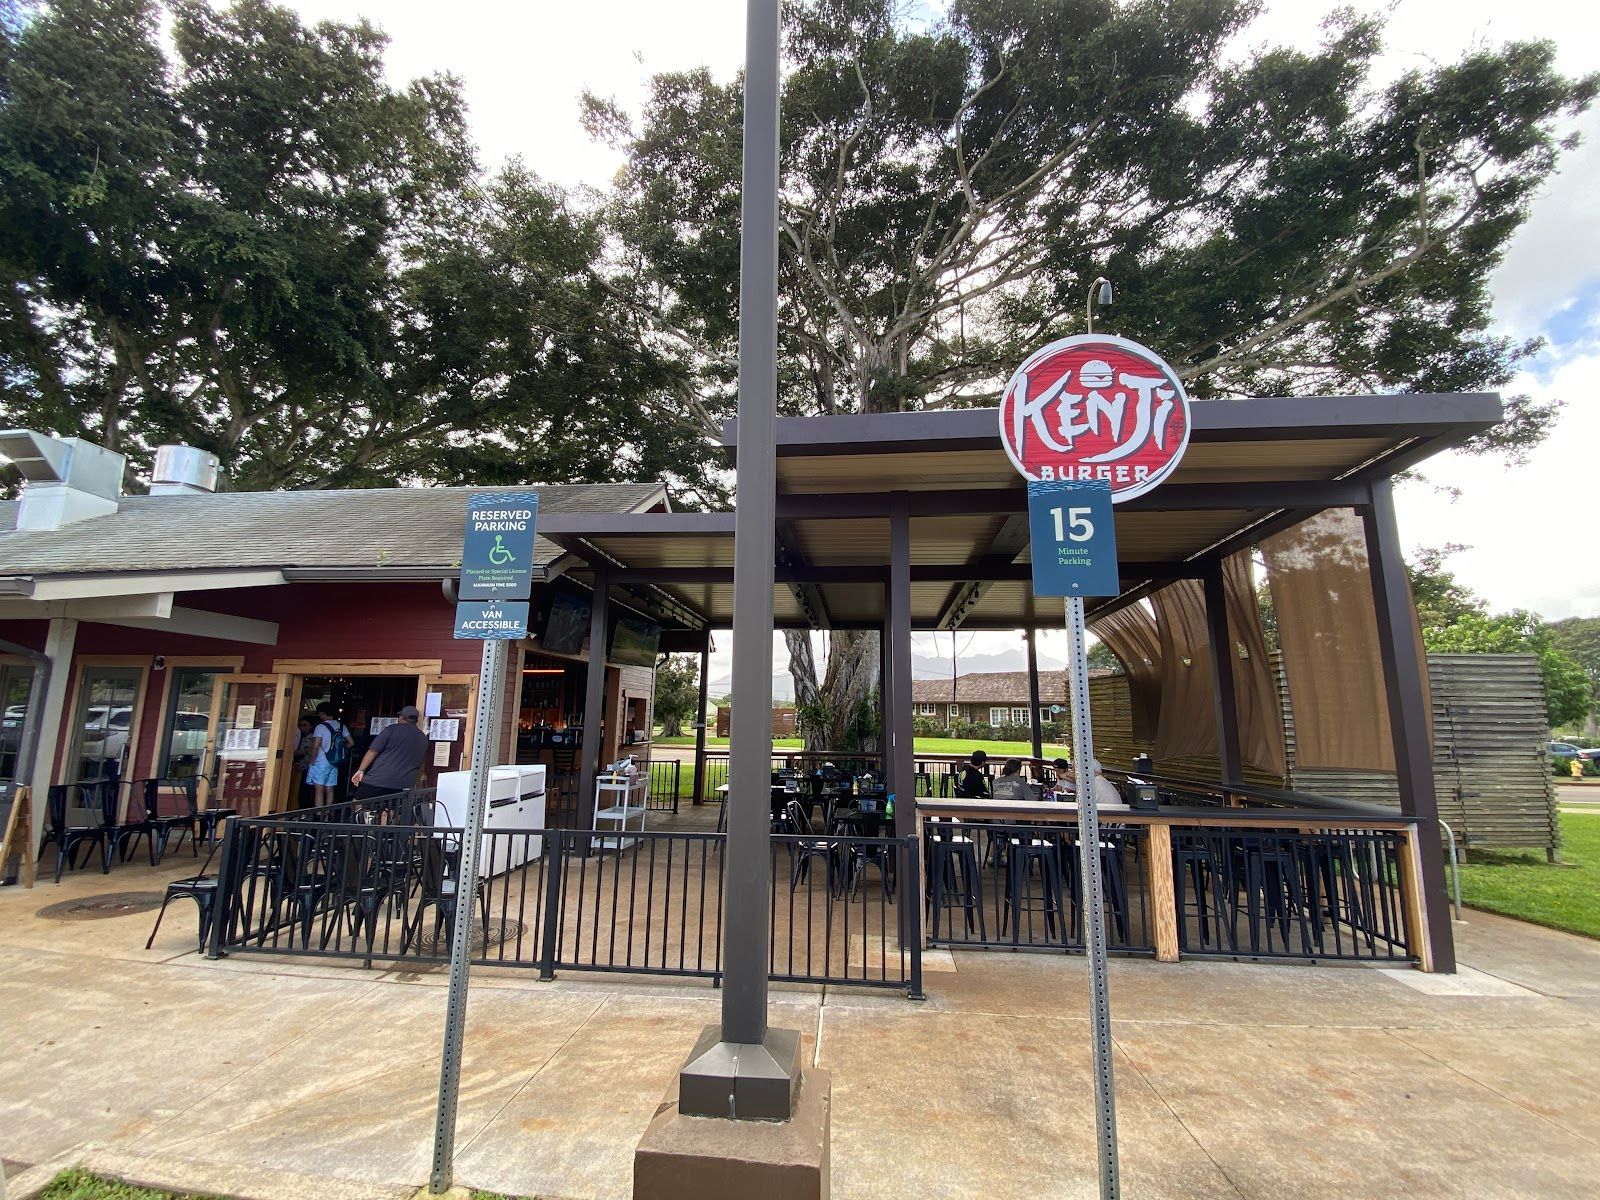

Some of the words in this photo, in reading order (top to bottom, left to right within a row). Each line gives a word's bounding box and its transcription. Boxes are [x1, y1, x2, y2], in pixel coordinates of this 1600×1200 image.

[1040, 465, 1149, 482] BURGER
[472, 510, 532, 520] RESERVED
[474, 521, 527, 531] PARKING
[1050, 507, 1094, 542] 15
[1058, 547, 1088, 555] Minute
[1058, 557, 1091, 566] Parking
[482, 611, 503, 619] VAN
[462, 620, 520, 629] ACCESSIBLE
